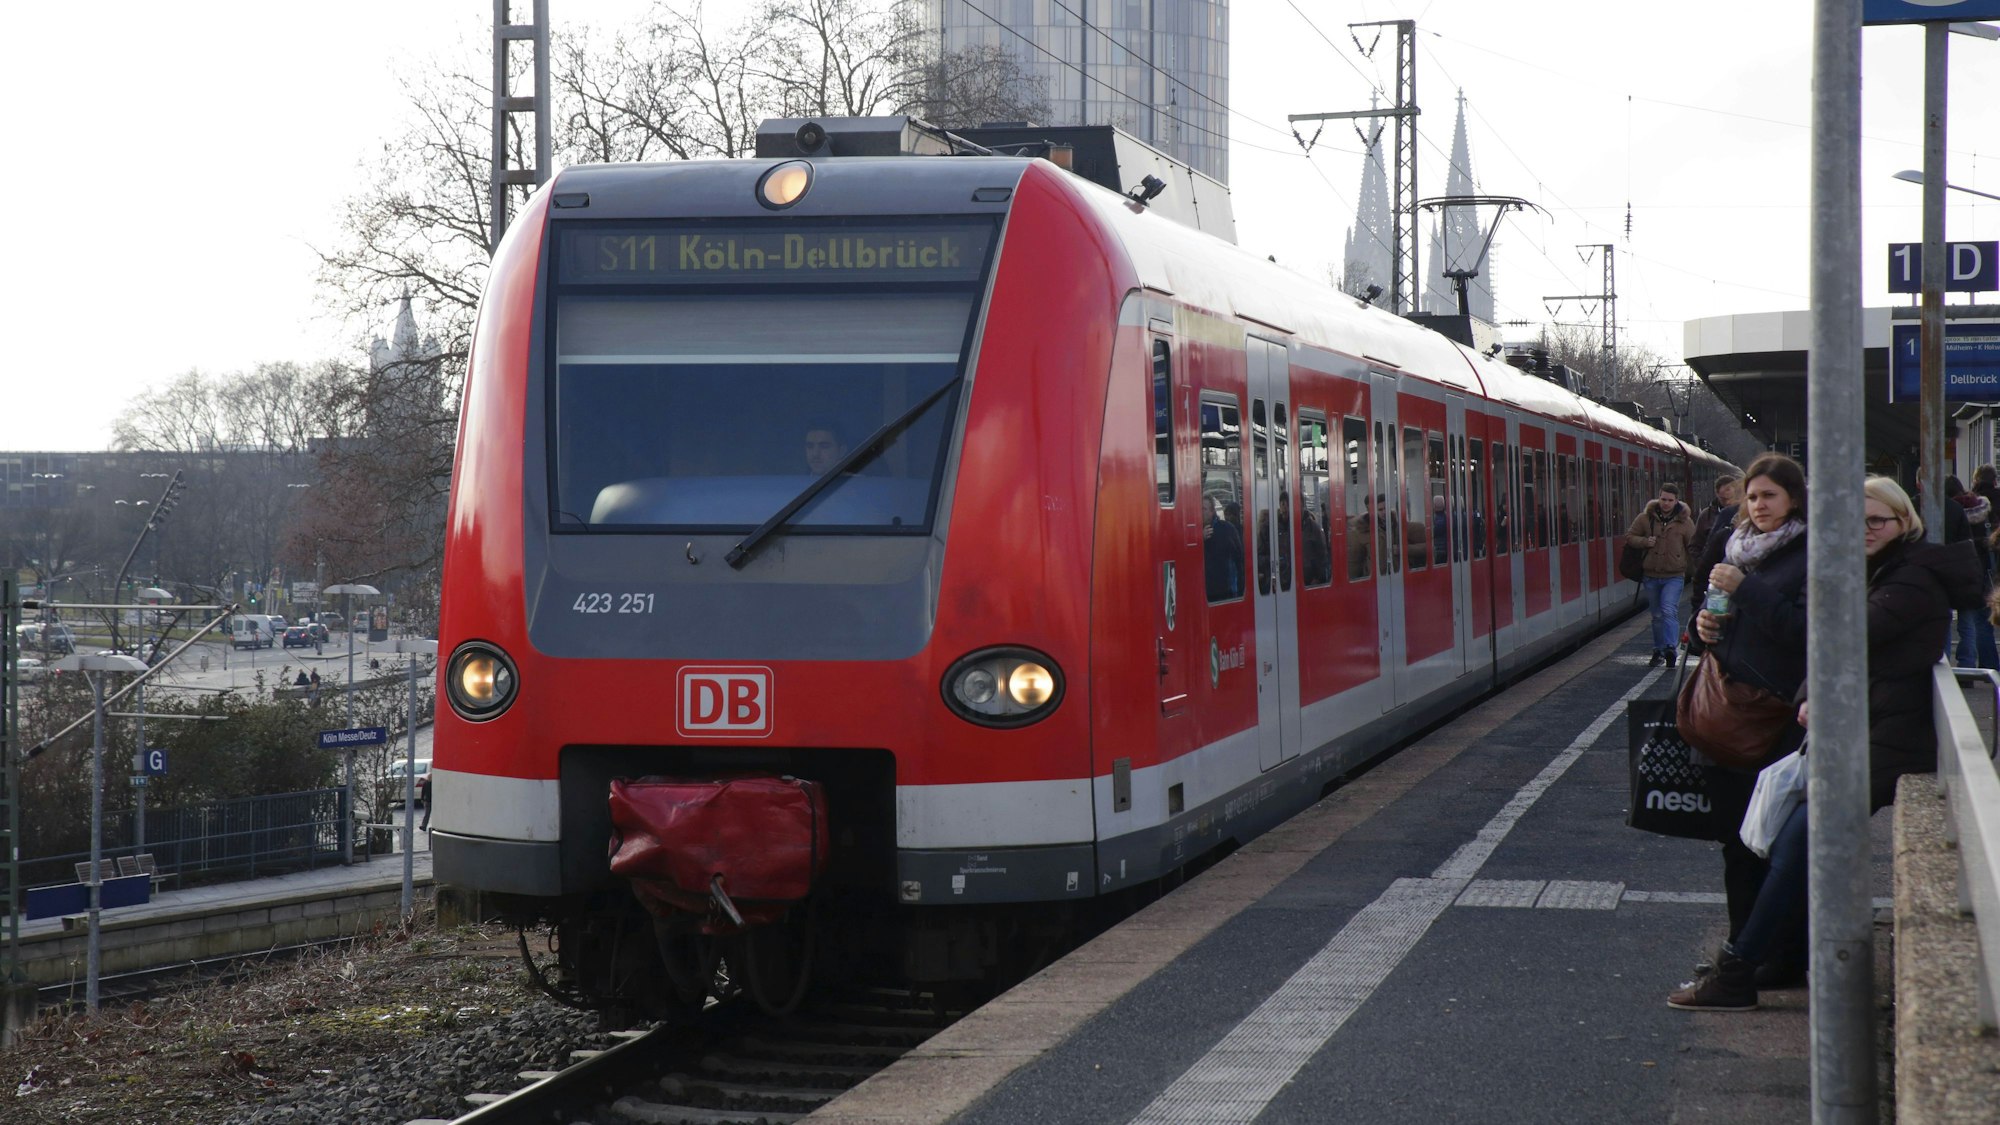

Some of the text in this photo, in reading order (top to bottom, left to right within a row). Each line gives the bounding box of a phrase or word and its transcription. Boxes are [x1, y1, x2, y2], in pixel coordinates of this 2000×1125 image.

[601, 233, 960, 271] S11 Köln-Dellbrück
[1895, 244, 1982, 281] 1 D
[1906, 338, 1915, 356] 1
[1950, 374, 1998, 385] Dellbrück
[1791, 442, 1801, 457] E
[573, 593, 655, 613] 423 251
[690, 678, 762, 725] DB
[323, 730, 377, 744] Köln Messe/Deutz
[150, 750, 163, 770] G
